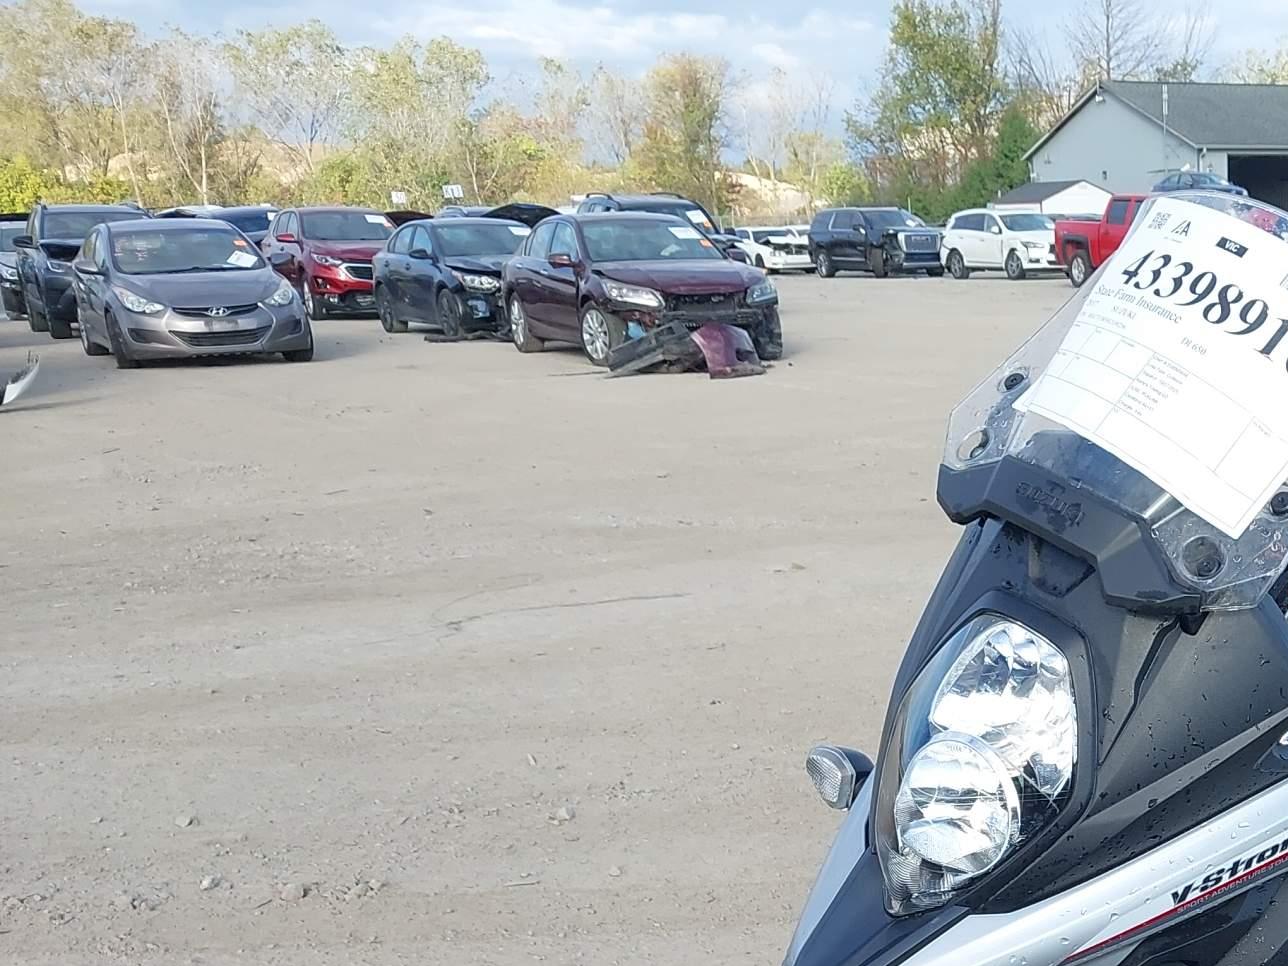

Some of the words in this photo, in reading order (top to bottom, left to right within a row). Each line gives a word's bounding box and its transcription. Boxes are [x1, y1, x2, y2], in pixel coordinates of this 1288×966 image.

[1225, 239, 1239, 253] VIC
[1095, 286, 1115, 298] State
[1114, 288, 1136, 303] Farm
[1136, 295, 1182, 323] Insurance
[1016, 481, 1086, 527] SUZUKI
[1177, 894, 1210, 914] SPORT
[1211, 865, 1268, 898] ADVENTURE
